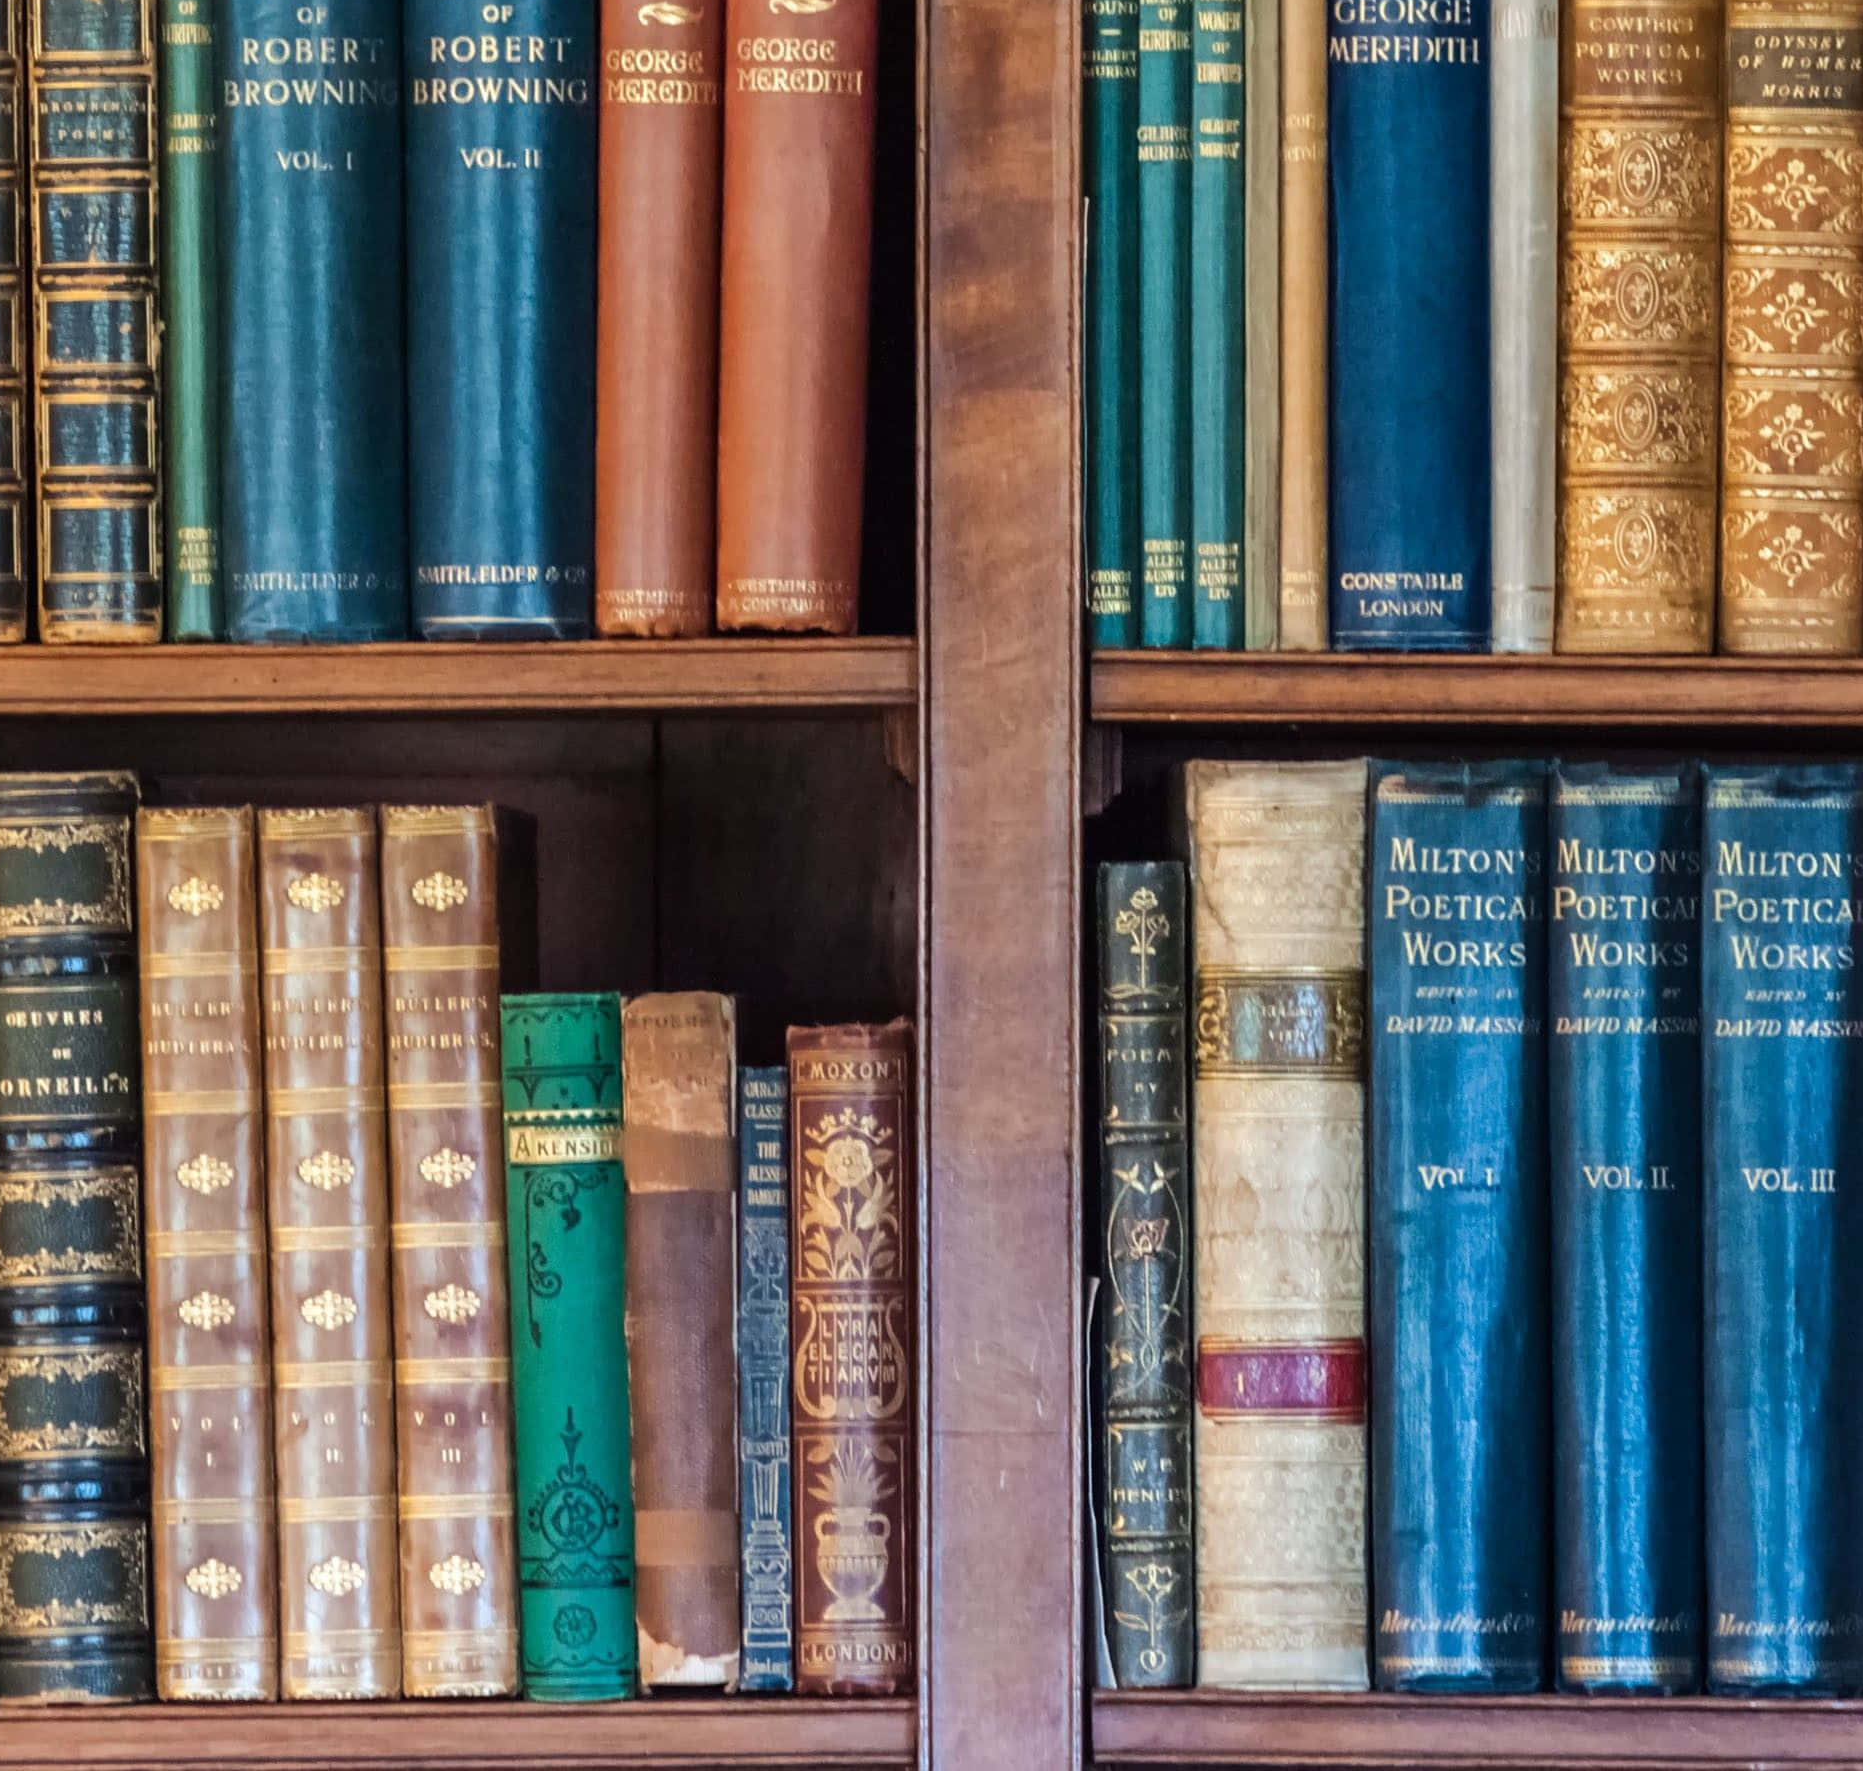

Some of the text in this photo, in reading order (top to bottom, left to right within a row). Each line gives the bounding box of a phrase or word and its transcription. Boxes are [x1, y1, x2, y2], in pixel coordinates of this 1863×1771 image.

[483, 4, 513, 23] OF
[431, 37, 571, 61] ROBERT
[738, 39, 835, 62] GEORGE
[1329, 36, 1480, 64] MEREDITH
[1754, 36, 1845, 52] ODYSSEY
[1738, 55, 1861, 71] OF HOMER
[414, 78, 586, 104] BROWNING
[738, 67, 862, 94] MEREDITH
[1762, 84, 1842, 99] MORRIS
[524, 147, 539, 168] II
[1341, 572, 1463, 591] CONSTABLE
[1360, 600, 1443, 618] LONDON
[1403, 933, 1527, 967] WORKS
[1731, 935, 1853, 969] WORKS
[810, 1061, 889, 1081] MOXON
[1810, 1169, 1835, 1192] III
[824, 1319, 880, 1339] LYRA
